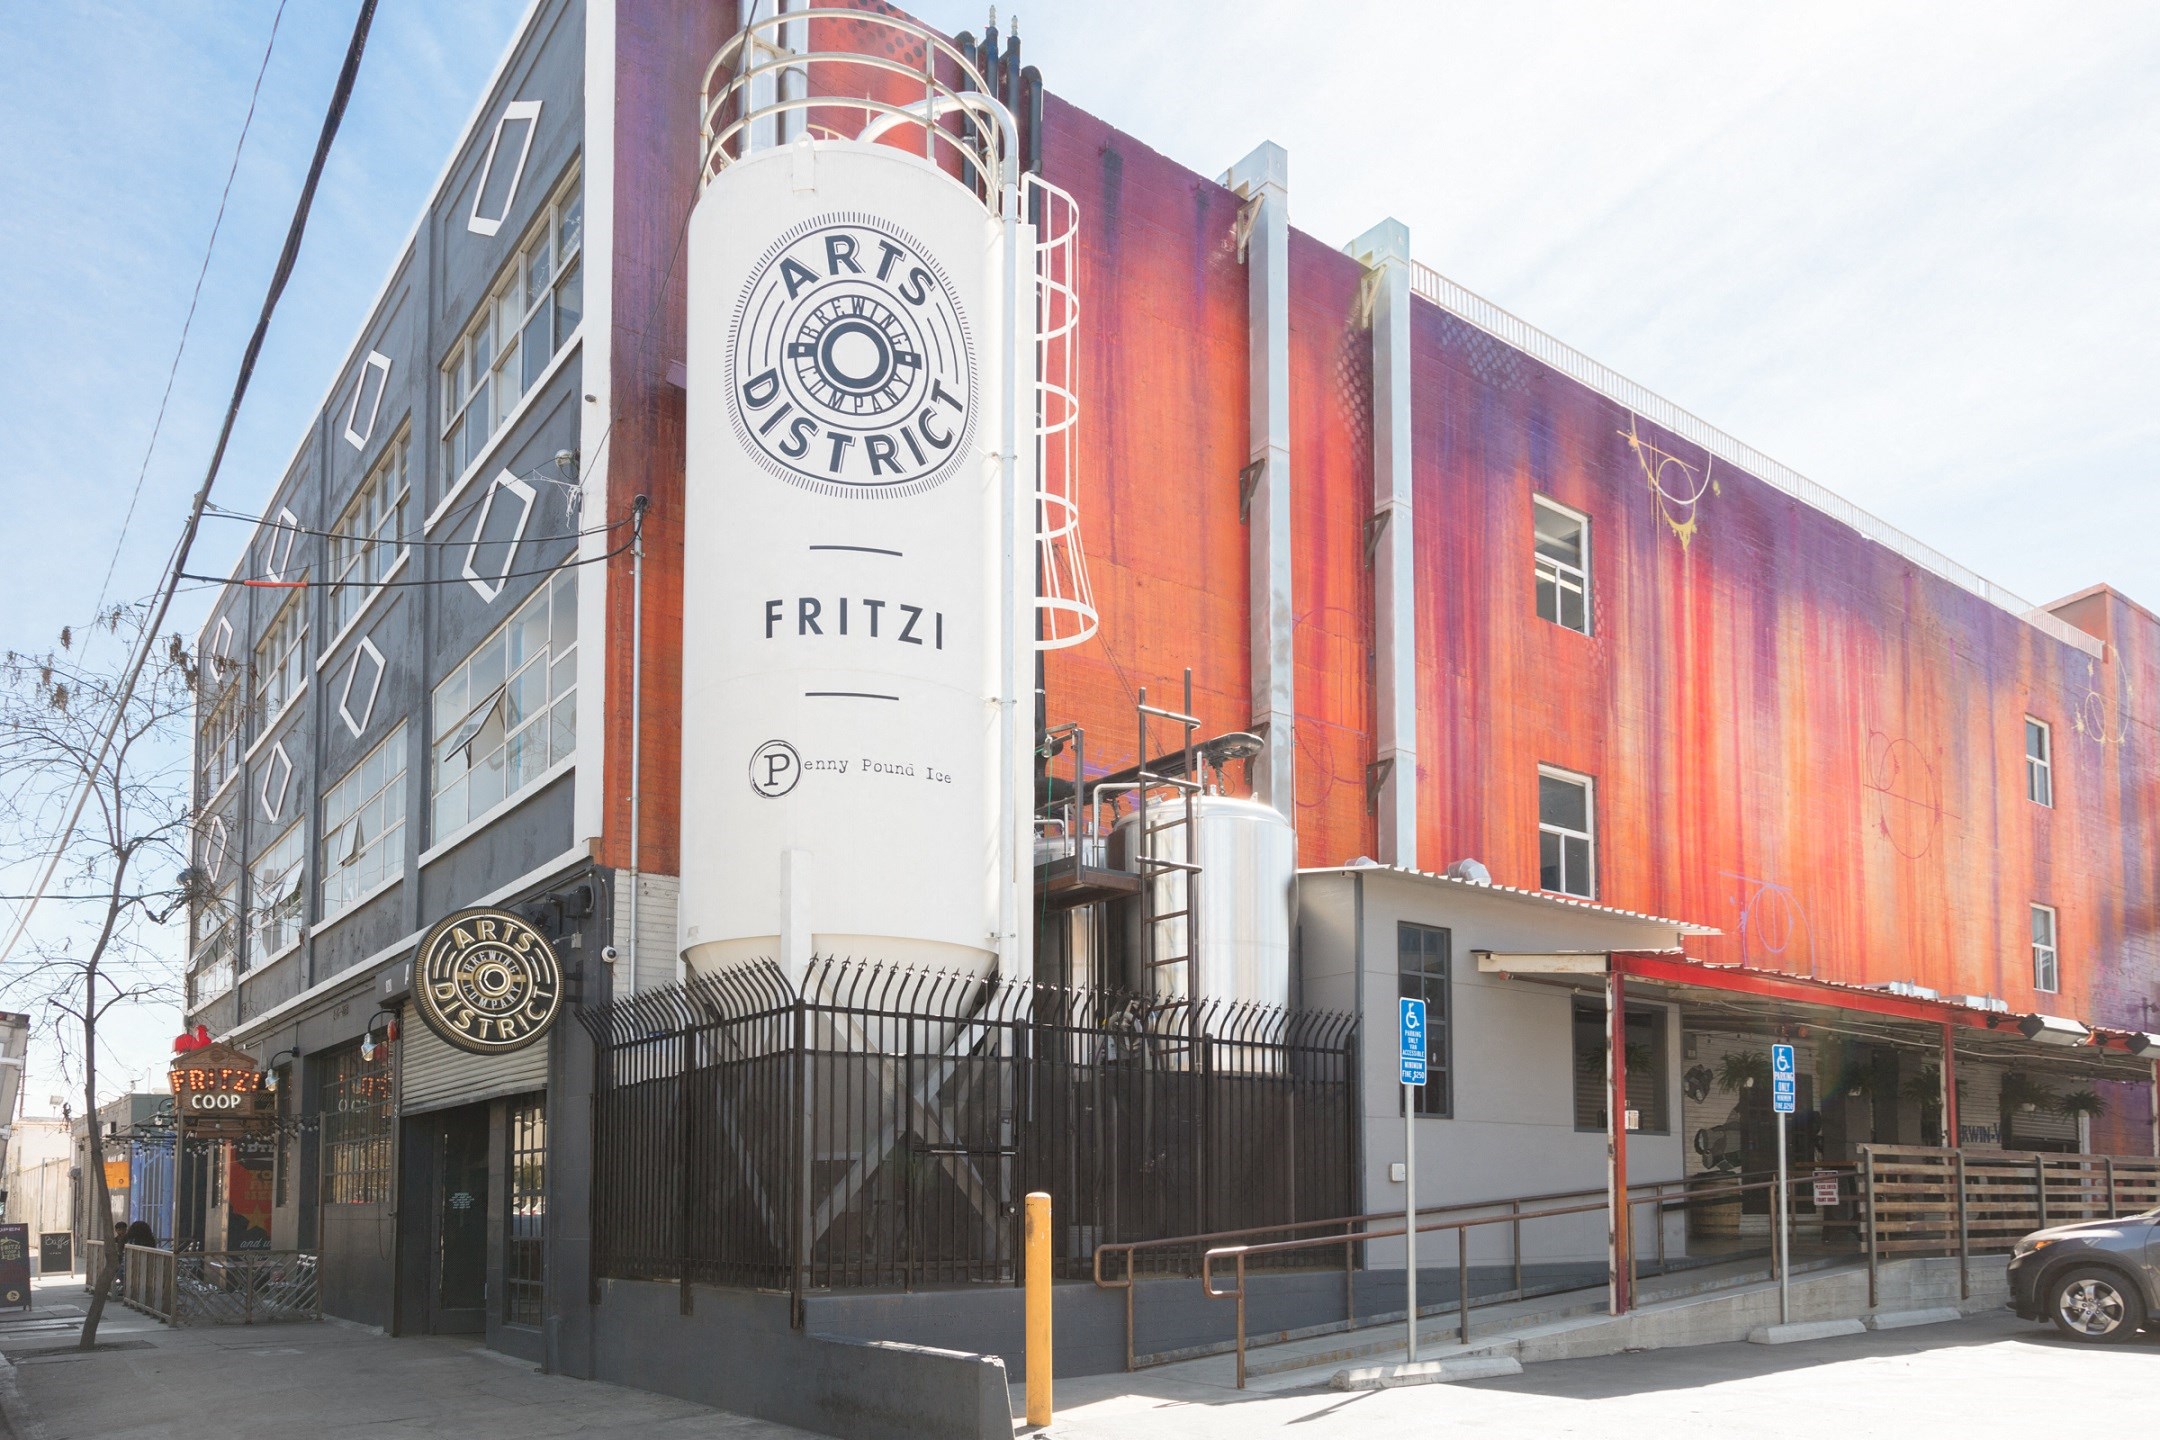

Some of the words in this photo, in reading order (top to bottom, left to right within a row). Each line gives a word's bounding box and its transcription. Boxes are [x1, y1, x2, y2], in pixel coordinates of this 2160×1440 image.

[778, 233, 936, 307] ARTS
[800, 296, 909, 346] BREWING
[799, 365, 911, 415] COMPANY
[742, 367, 964, 477] DISTRICT
[765, 596, 943, 651] FRITZI
[861, 758, 916, 777] Pound
[925, 766, 952, 784] Ice
[452, 920, 535, 952] ARTS
[463, 949, 519, 973] BREWING
[462, 983, 522, 1010] COMPANY
[430, 982, 553, 1039] DISTRICT
[1404, 1030, 1421, 1038] PARKING
[1402, 1049, 1424, 1057] ACCESSIBLE
[170, 1068, 261, 1093] FRITZI
[1402, 1070, 1412, 1078] FINE
[1774, 1071, 1794, 1081] PARKING
[1778, 1082, 1790, 1091] ONLY
[191, 1094, 242, 1109] COOP
